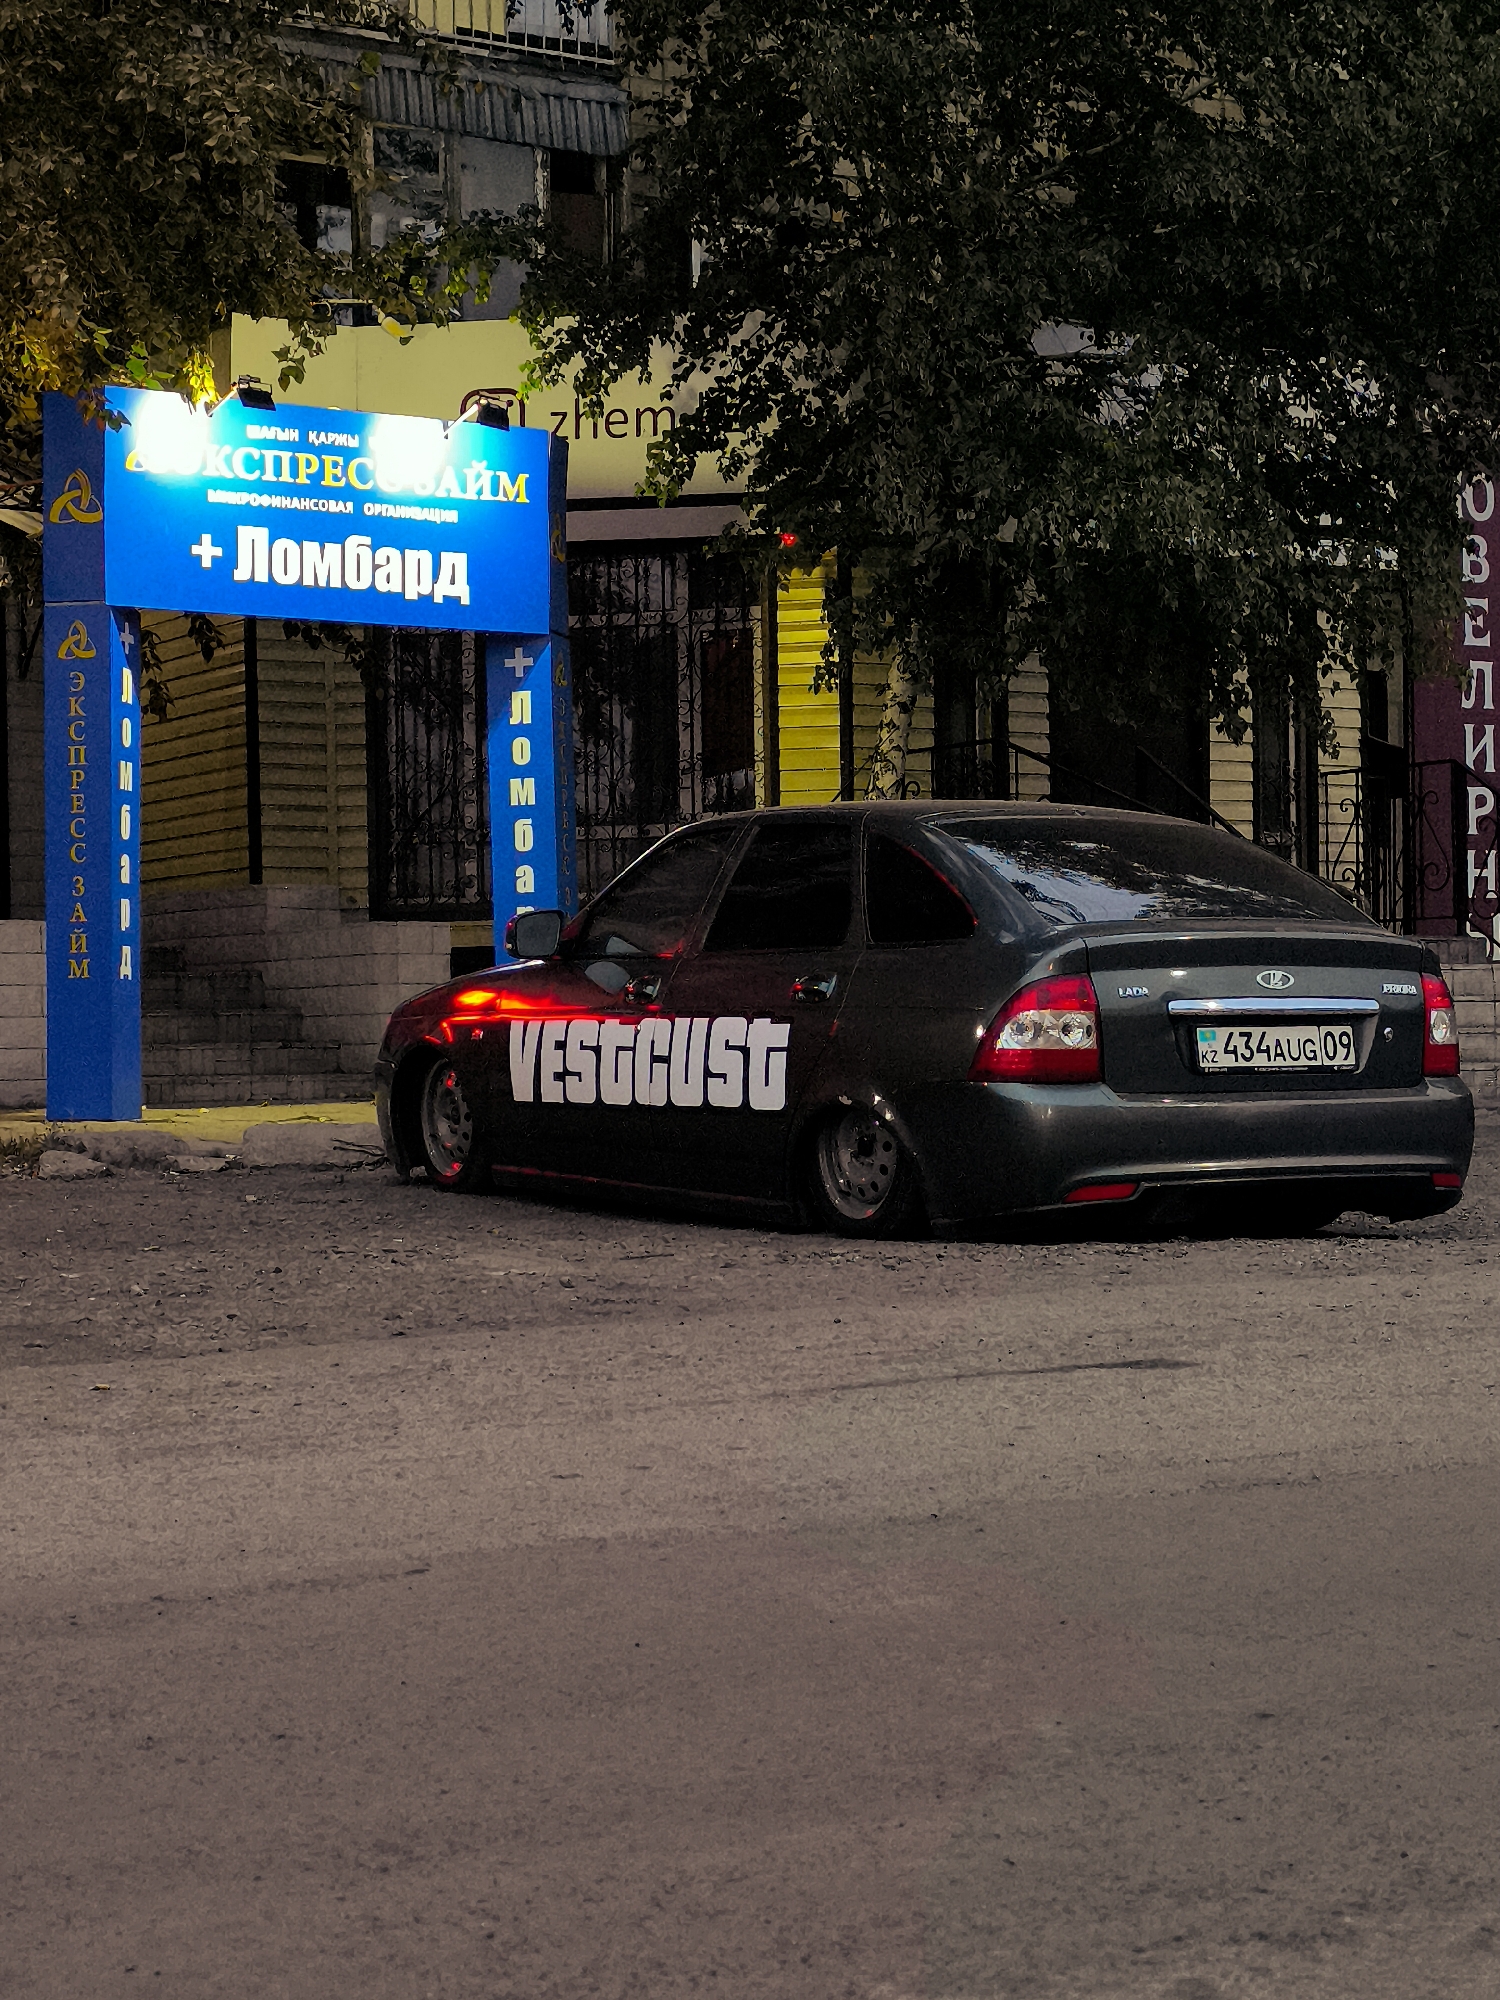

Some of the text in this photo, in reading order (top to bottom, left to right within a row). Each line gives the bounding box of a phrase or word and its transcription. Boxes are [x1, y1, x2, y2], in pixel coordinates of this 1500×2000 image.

[308, 431, 360, 448] ҚАРЖЫ
[207, 488, 459, 525] МИКРОФИНАНСОВАЯ ОРГАНИЗАЦИЯ
[233, 525, 471, 606] Ломбард
[67, 671, 91, 979] ЭКСПРЕСС ЗАЙМ
[1117, 985, 1149, 998] LADA
[1201, 1050, 1219, 1063] KZ
